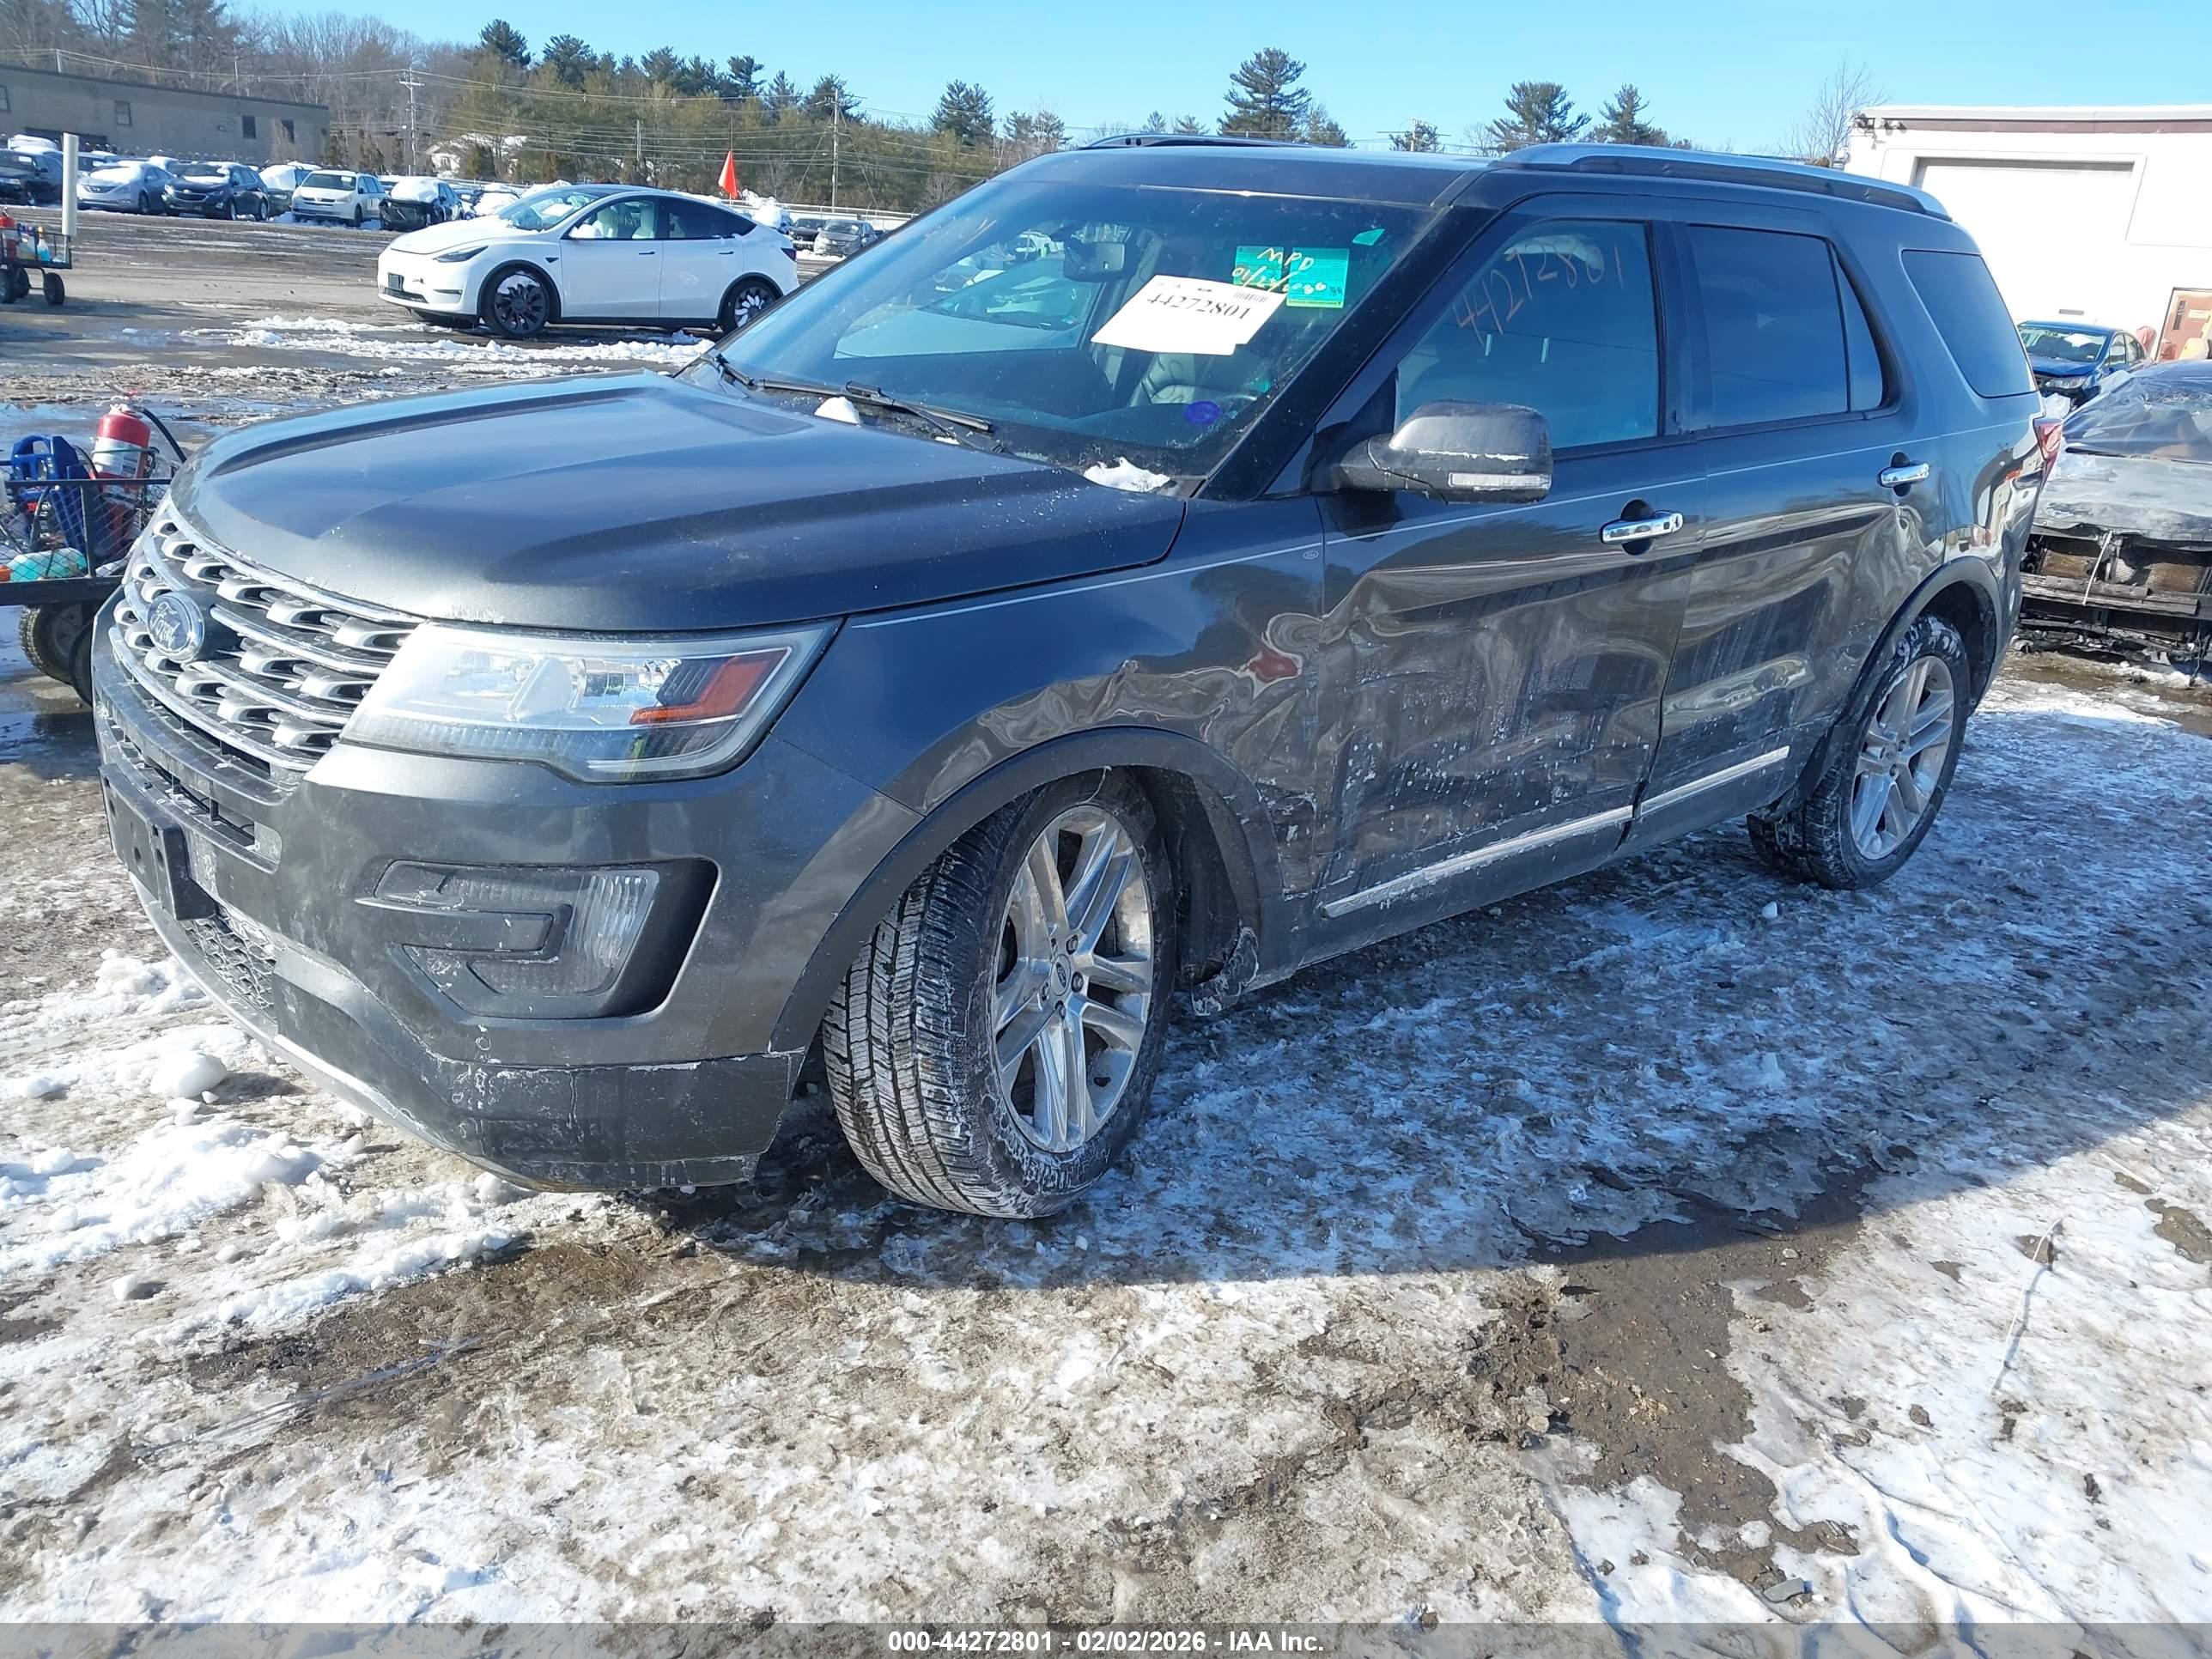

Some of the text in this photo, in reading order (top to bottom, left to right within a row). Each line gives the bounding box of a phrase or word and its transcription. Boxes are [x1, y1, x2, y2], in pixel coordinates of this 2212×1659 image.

[1256, 246, 1315, 271] MPD
[1146, 293, 1252, 319] 44272801
[1451, 241, 1625, 350] 44272801
